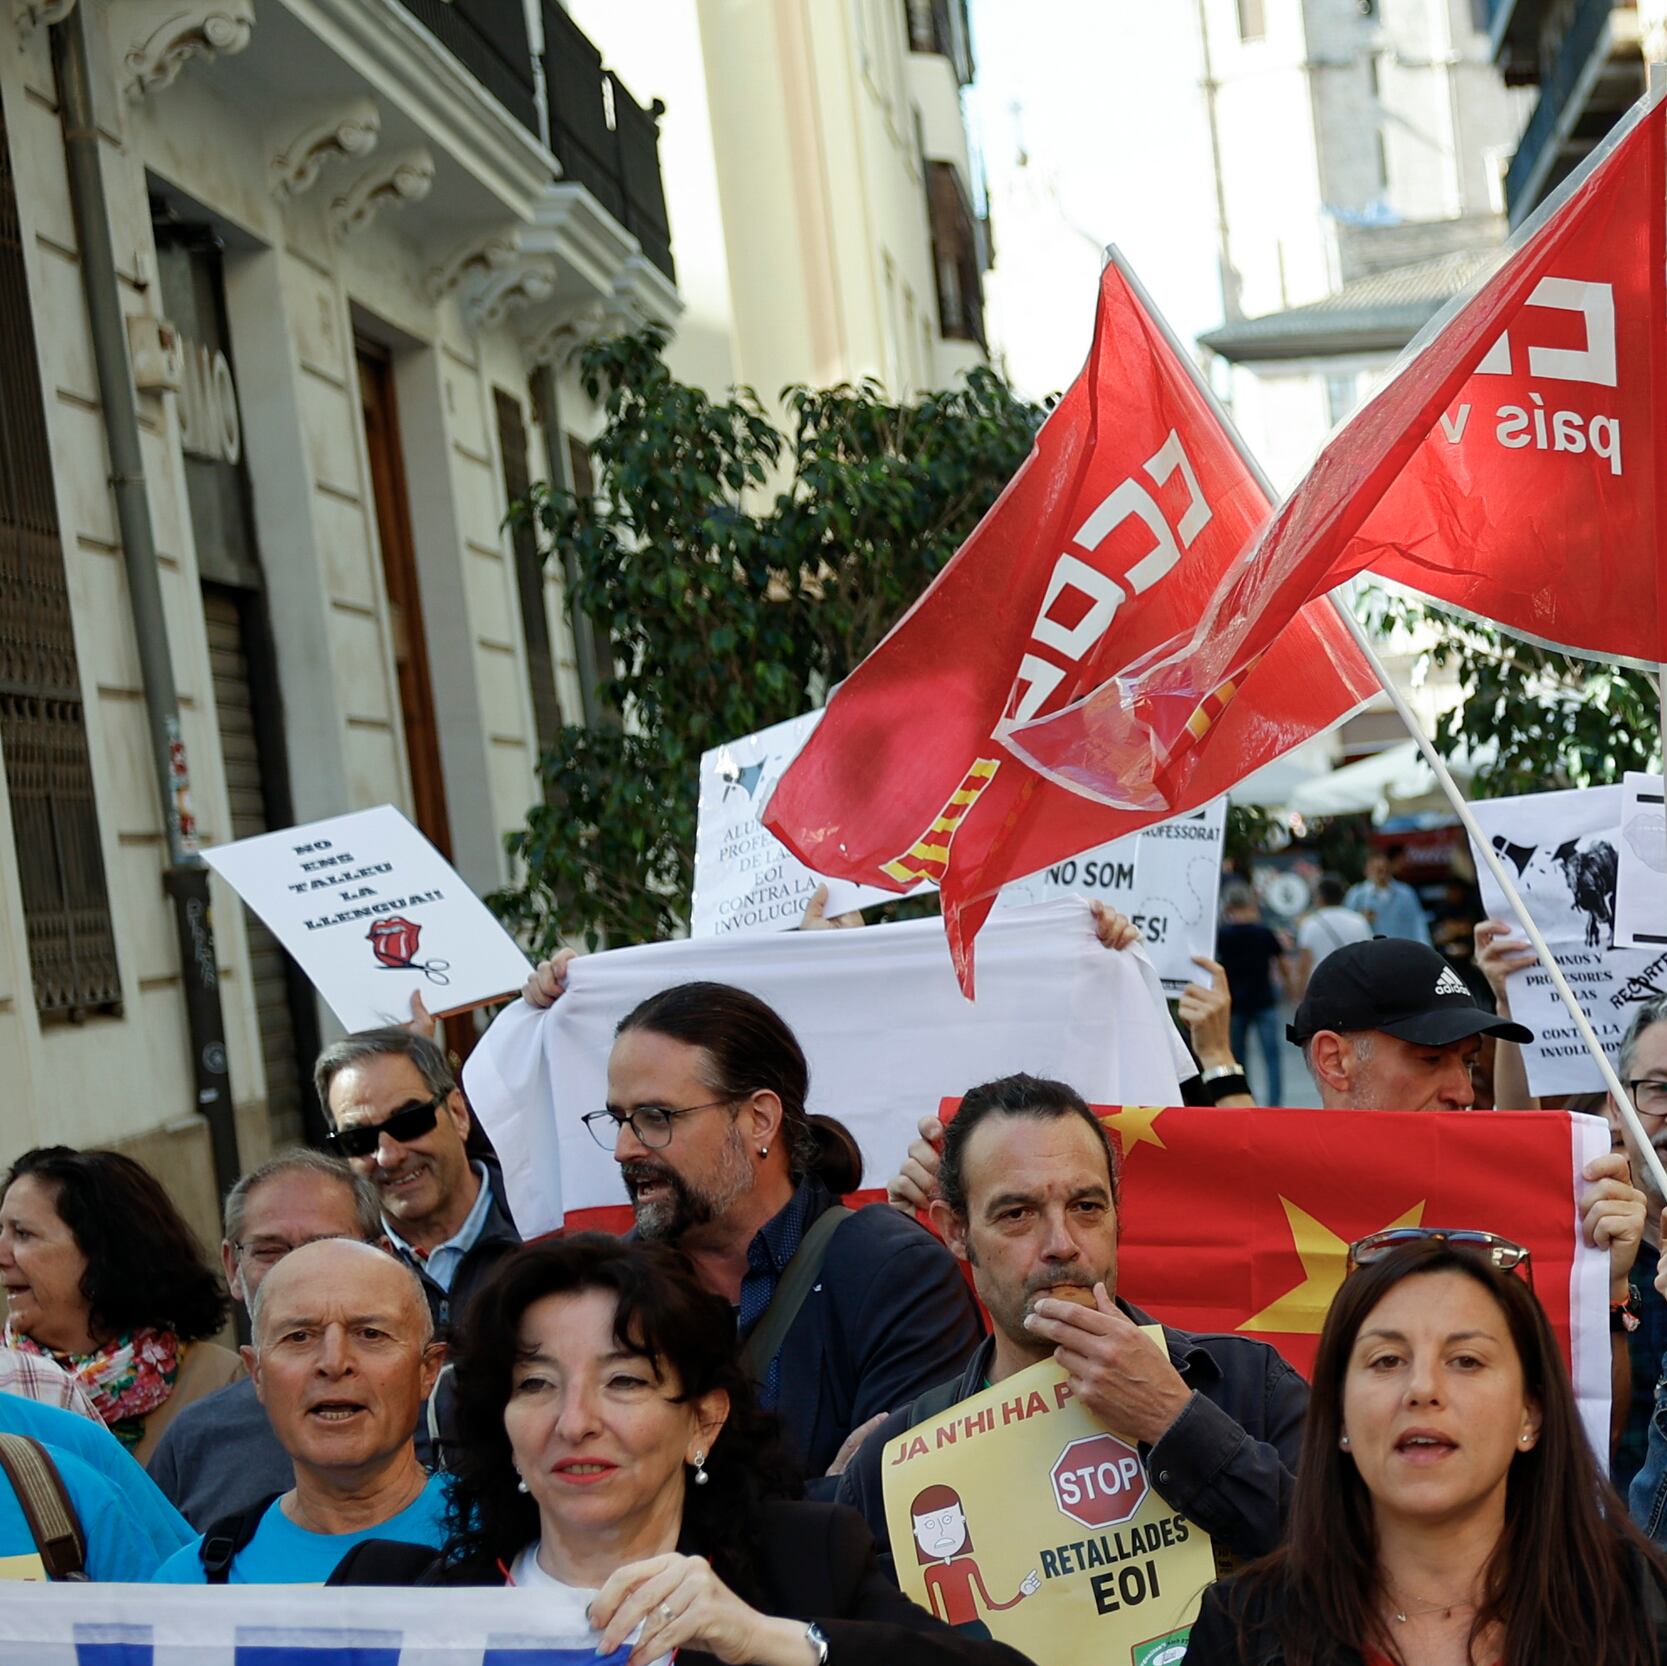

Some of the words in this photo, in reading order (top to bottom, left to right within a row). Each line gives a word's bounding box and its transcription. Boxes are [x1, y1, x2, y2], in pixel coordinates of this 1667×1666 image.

[292, 840, 332, 855] NO
[300, 852, 354, 872] ENS
[288, 862, 393, 894] TALLEU
[1082, 861, 1135, 890] SOM
[339, 885, 378, 901] LA
[718, 882, 792, 916] CONTRA
[1435, 983, 1472, 997] adidas
[890, 1436, 930, 1467] JA
[935, 1407, 995, 1449] N'HI
[1002, 1390, 1050, 1425] HA
[1057, 1456, 1139, 1506] STOP
[1039, 1514, 1190, 1579] RETALLADES
[1089, 1559, 1162, 1616] EOI
